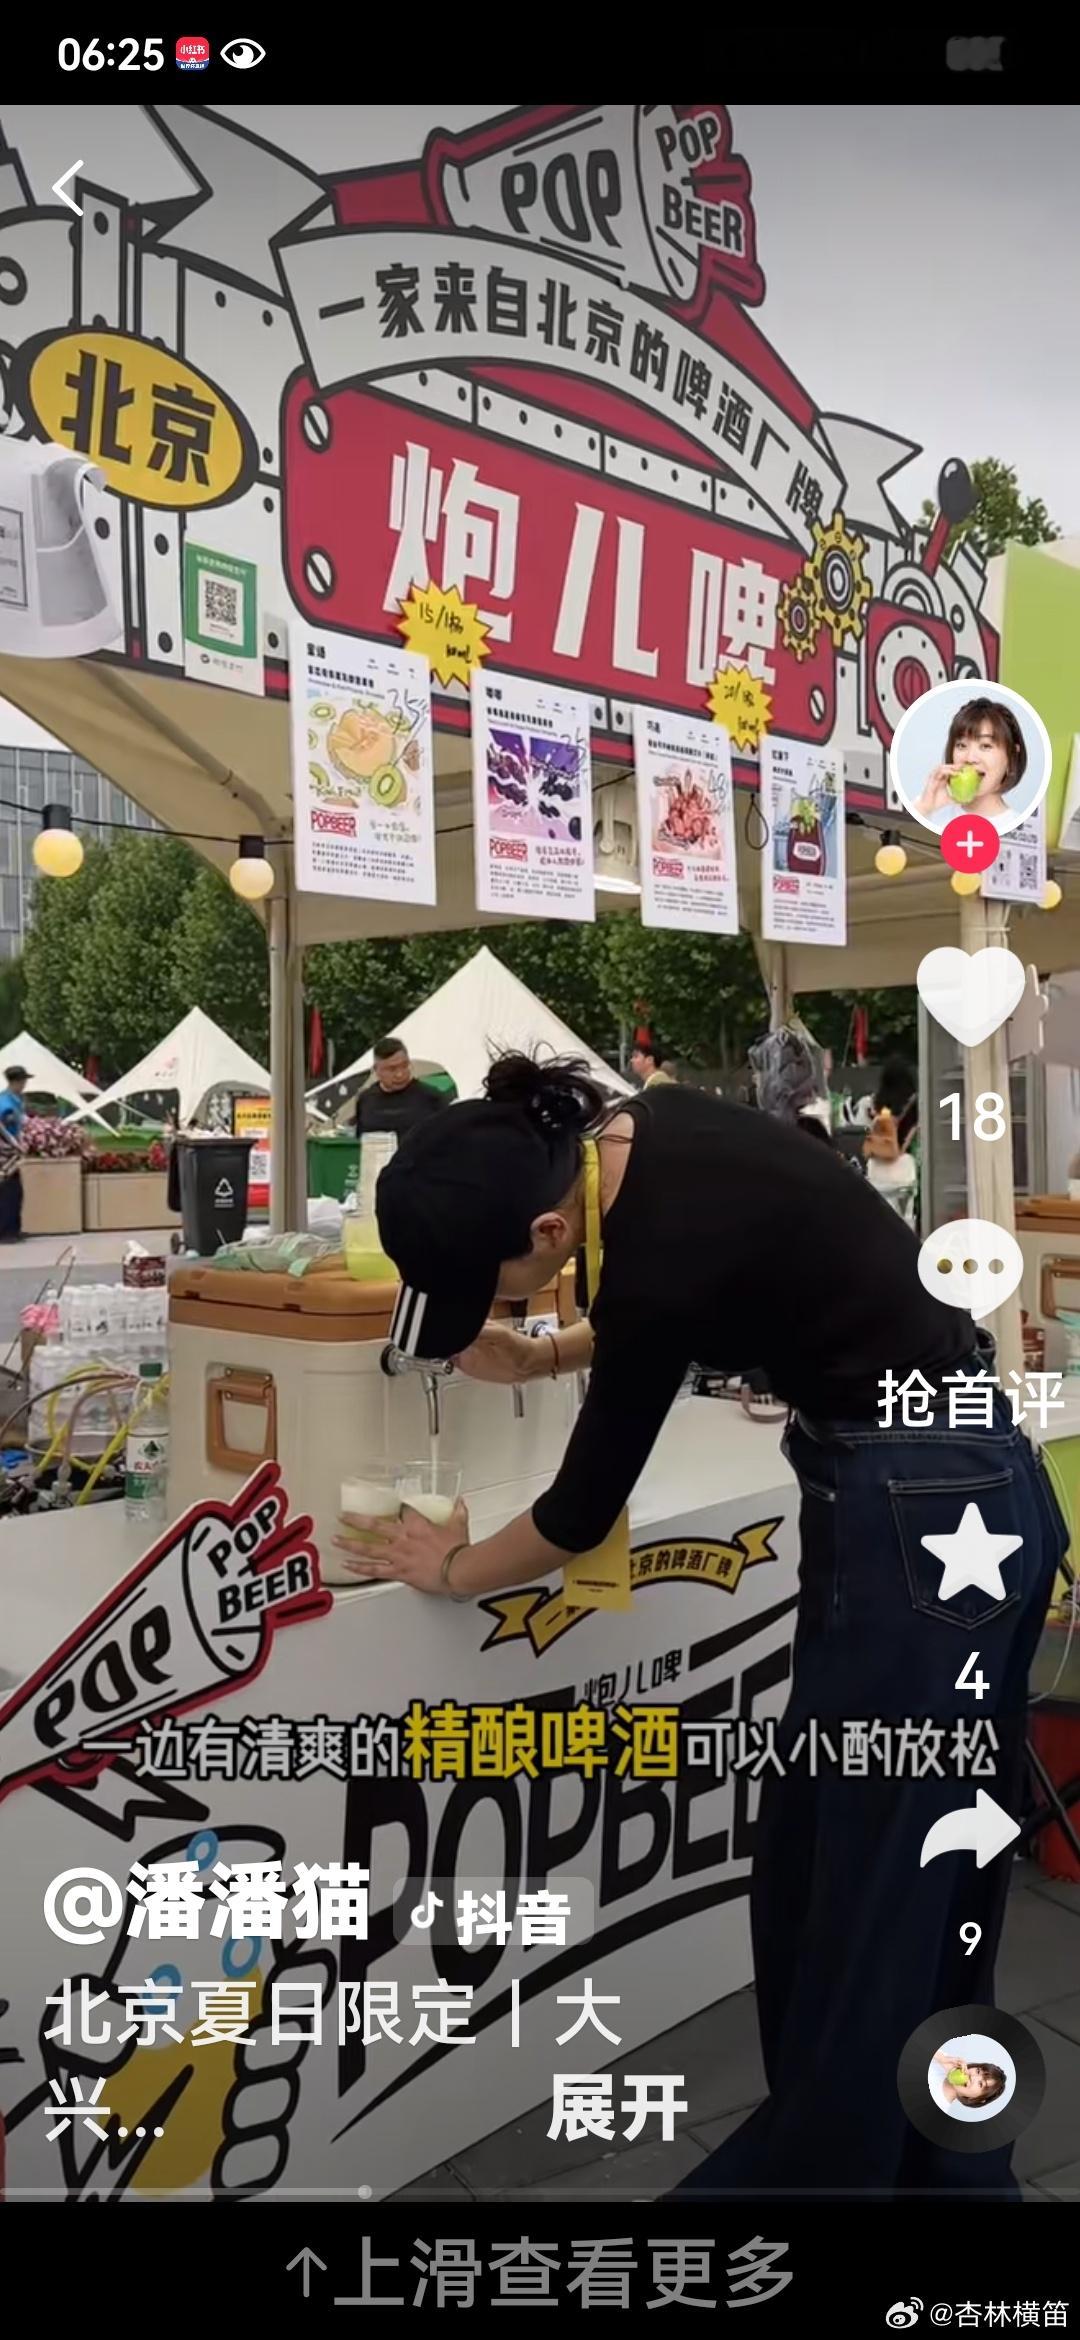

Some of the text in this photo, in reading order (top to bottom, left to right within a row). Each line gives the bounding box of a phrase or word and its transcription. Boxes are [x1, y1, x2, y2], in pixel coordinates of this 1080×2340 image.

[655, 117, 718, 173] POP
[501, 149, 622, 248] POP
[663, 184, 742, 252] BEER
[60, 349, 216, 486] 北京
[319, 262, 823, 527] 一家来自北京的啤酒厂牌
[383, 441, 780, 687] 炮儿啤
[206, 1500, 278, 1578] POP
[217, 1555, 310, 1623] BEER
[583, 1648, 683, 1706] 炮儿啤
